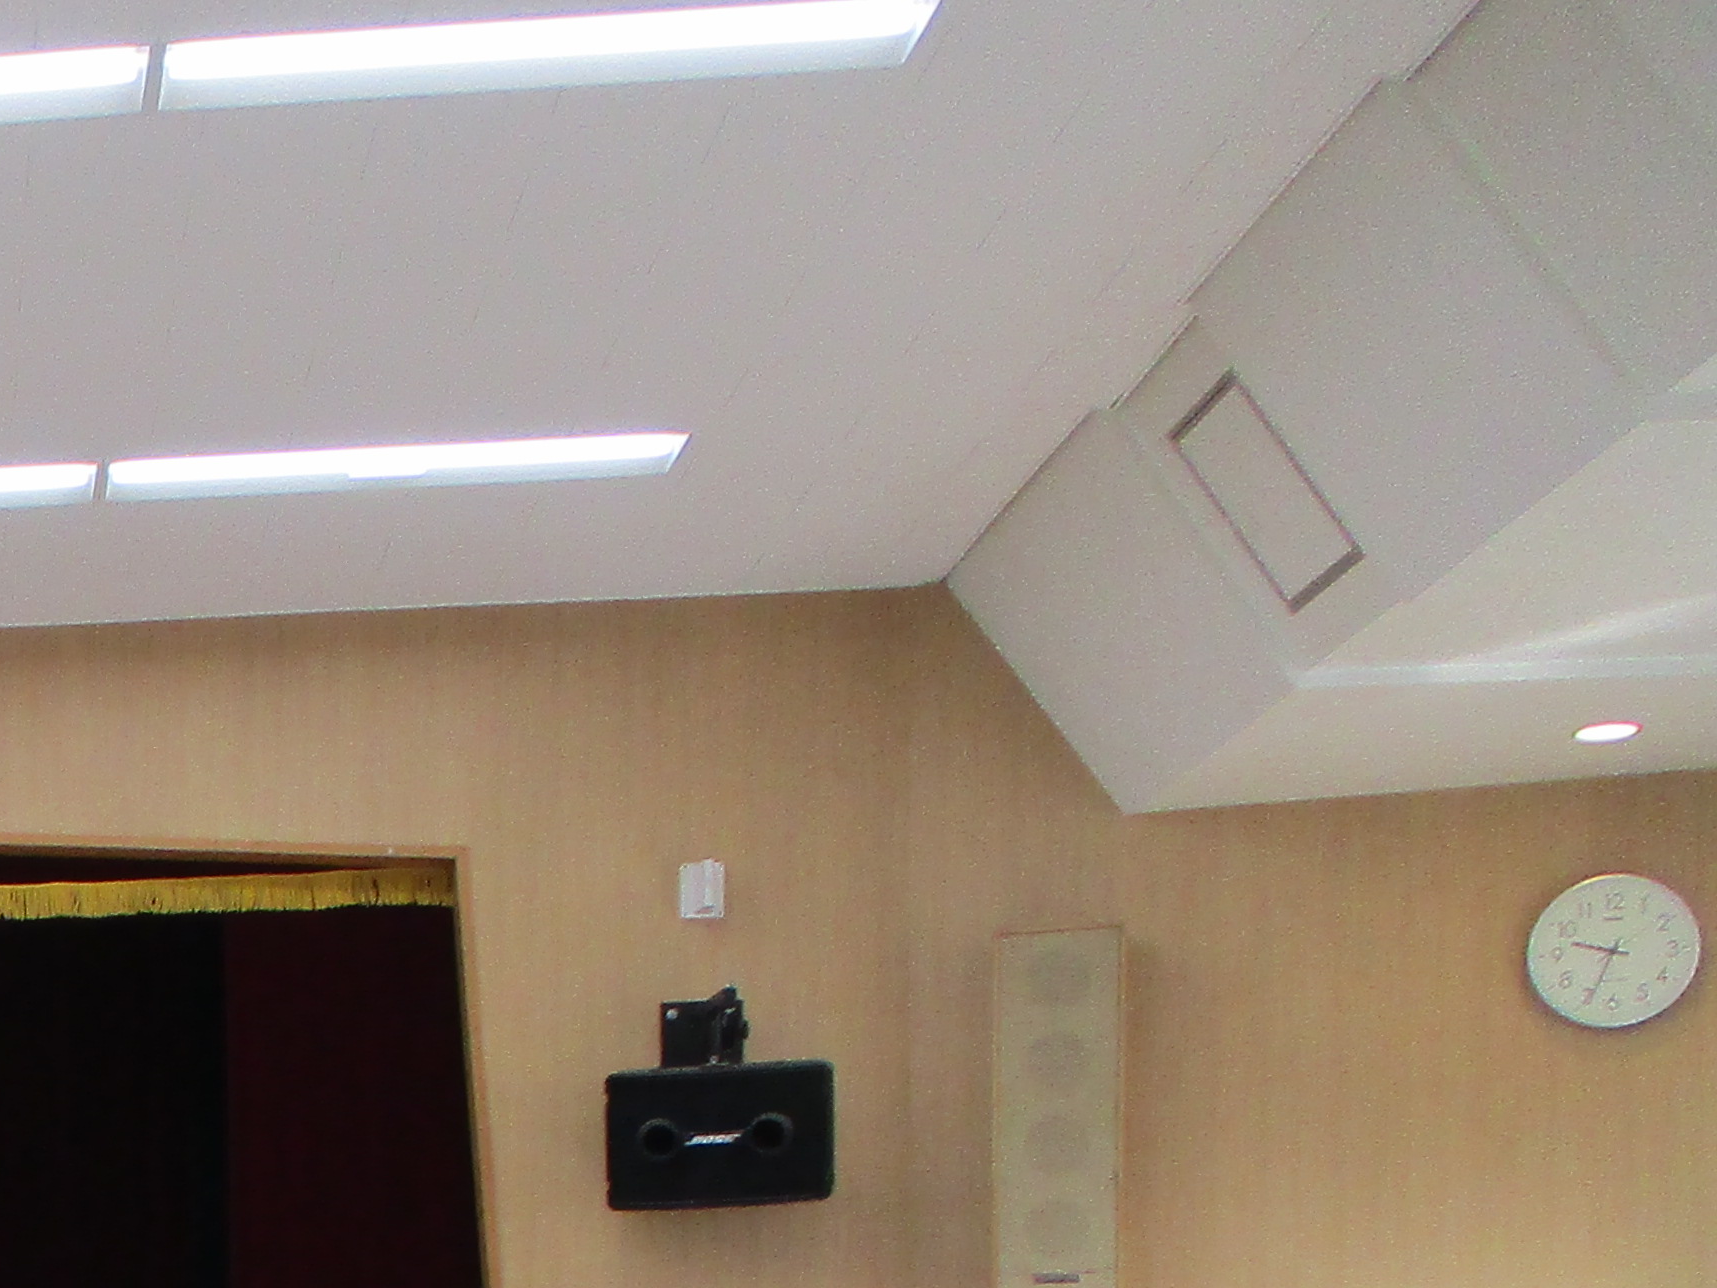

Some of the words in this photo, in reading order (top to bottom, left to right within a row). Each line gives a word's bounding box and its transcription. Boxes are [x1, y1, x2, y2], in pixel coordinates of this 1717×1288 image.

[1605, 892, 1625, 911] 12
[1655, 913, 1672, 932] 2
[1551, 946, 1564, 962] 9
[1666, 939, 1680, 958] 3
[1656, 966, 1669, 983] 4
